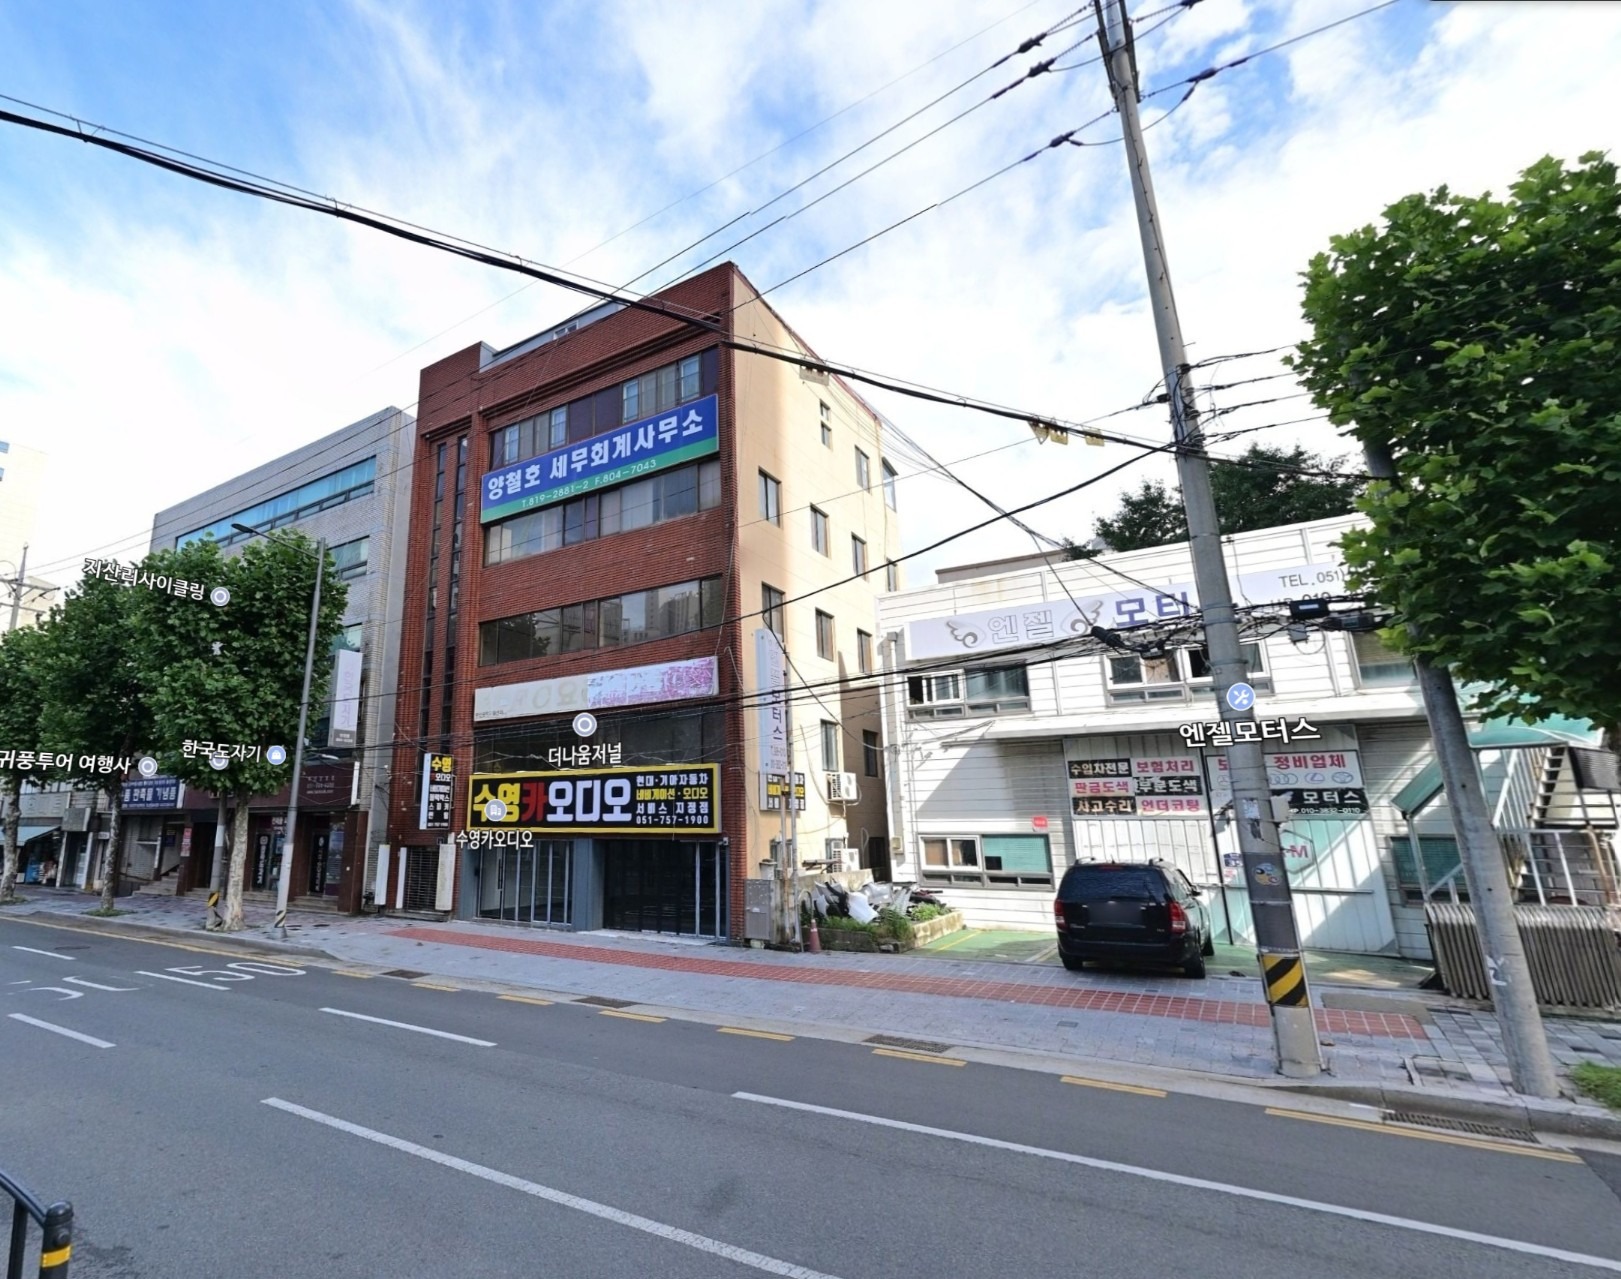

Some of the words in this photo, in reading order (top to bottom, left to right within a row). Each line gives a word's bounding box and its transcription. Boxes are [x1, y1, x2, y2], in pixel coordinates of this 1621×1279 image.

[488, 463, 541, 500] 양철호
[549, 409, 703, 480] 세무회계사무소
[521, 480, 589, 509] T.819-2881-2
[594, 459, 657, 486] F.804-7043
[987, 610, 1055, 645] 엔젤
[1115, 591, 1191, 628] 모터
[432, 756, 452, 773] 수영
[1071, 761, 1130, 776] 수입차전문
[1137, 759, 1195, 773] 보험처리
[1274, 754, 1347, 769] 정비업체
[1075, 781, 1130, 794] 판금도색
[473, 778, 632, 822] 수영카오디오
[1303, 791, 1361, 804] 모터스
[1077, 800, 1133, 813] 사고수리
[636, 815, 709, 824] 051-757-1900
